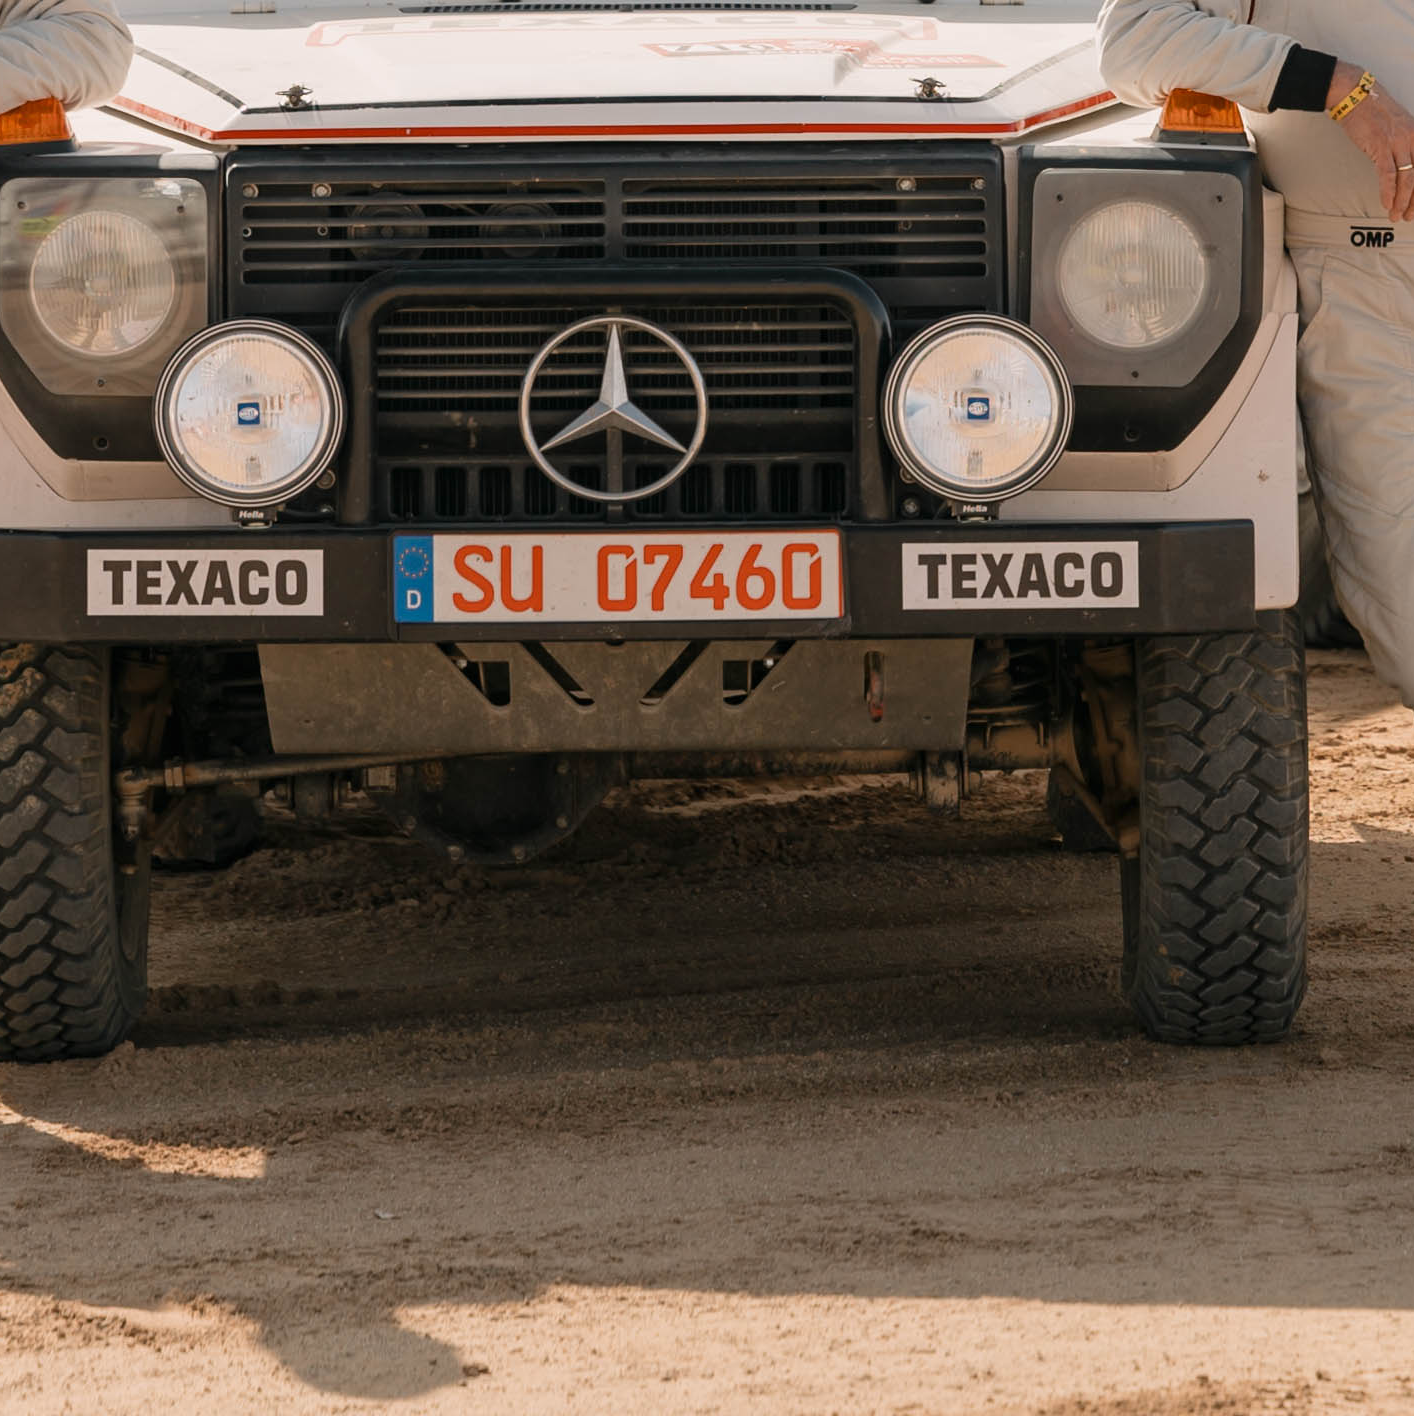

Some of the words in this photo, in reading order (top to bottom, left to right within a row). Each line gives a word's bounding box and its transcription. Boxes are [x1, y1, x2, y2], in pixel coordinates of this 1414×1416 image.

[1350, 229, 1395, 248] OMP
[239, 510, 265, 520] Hella
[962, 505, 988, 514] Hella
[103, 559, 308, 606] TEXACO
[452, 545, 544, 613] SU
[597, 543, 822, 612] 07460
[918, 552, 1124, 599] TEXACO
[406, 590, 421, 610] D
